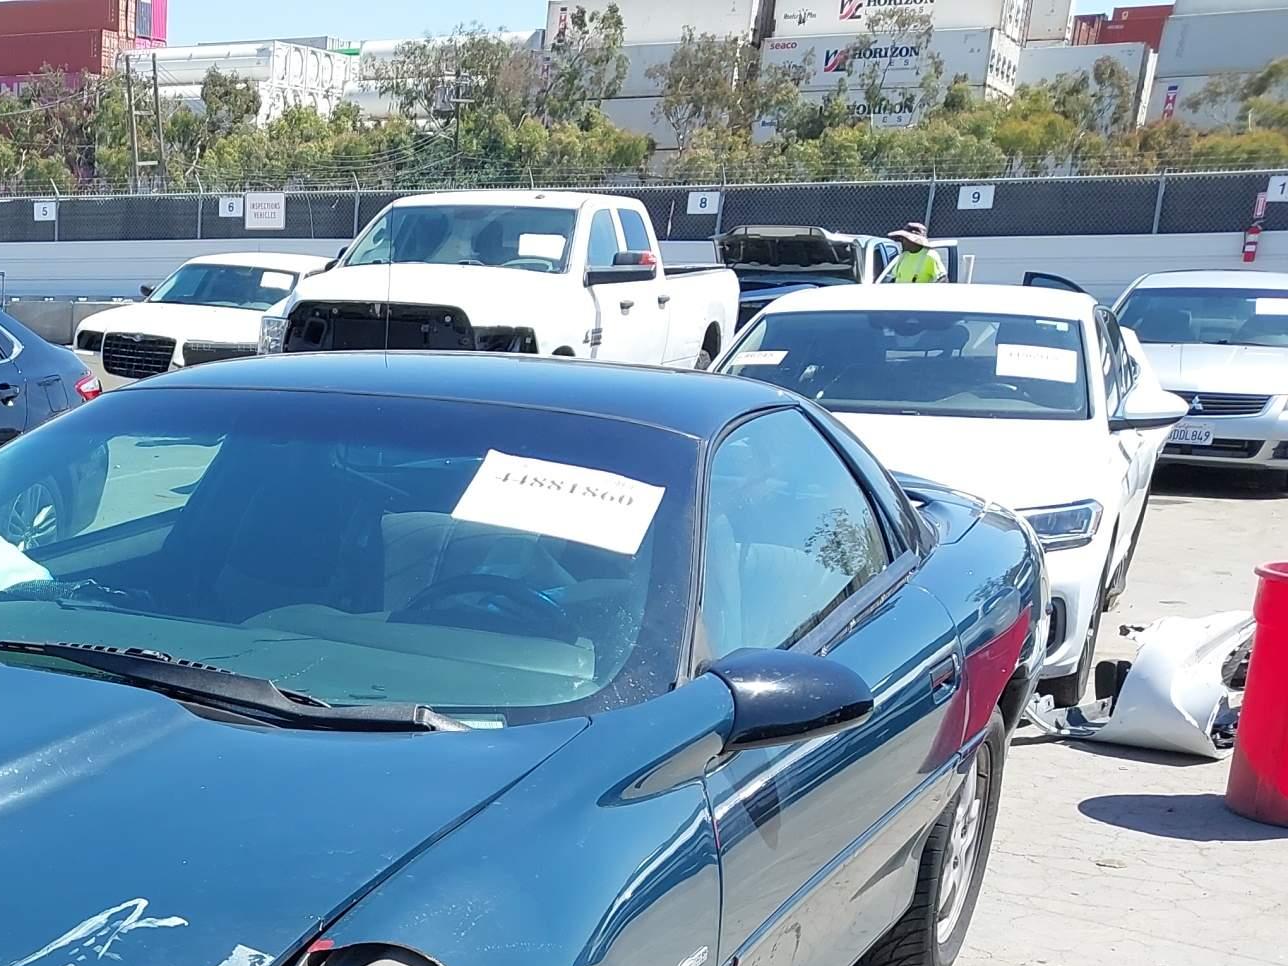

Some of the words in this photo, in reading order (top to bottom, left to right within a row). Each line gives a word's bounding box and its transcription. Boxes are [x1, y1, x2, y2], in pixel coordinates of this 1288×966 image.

[769, 42, 798, 50] seaco
[853, 46, 920, 60] HORIZON
[847, 101, 914, 115] ORION
[699, 197, 708, 209] 8
[972, 191, 981, 204] 9
[42, 206, 48, 216] 5
[228, 202, 235, 213] 6
[495, 472, 634, 506] 44881860
